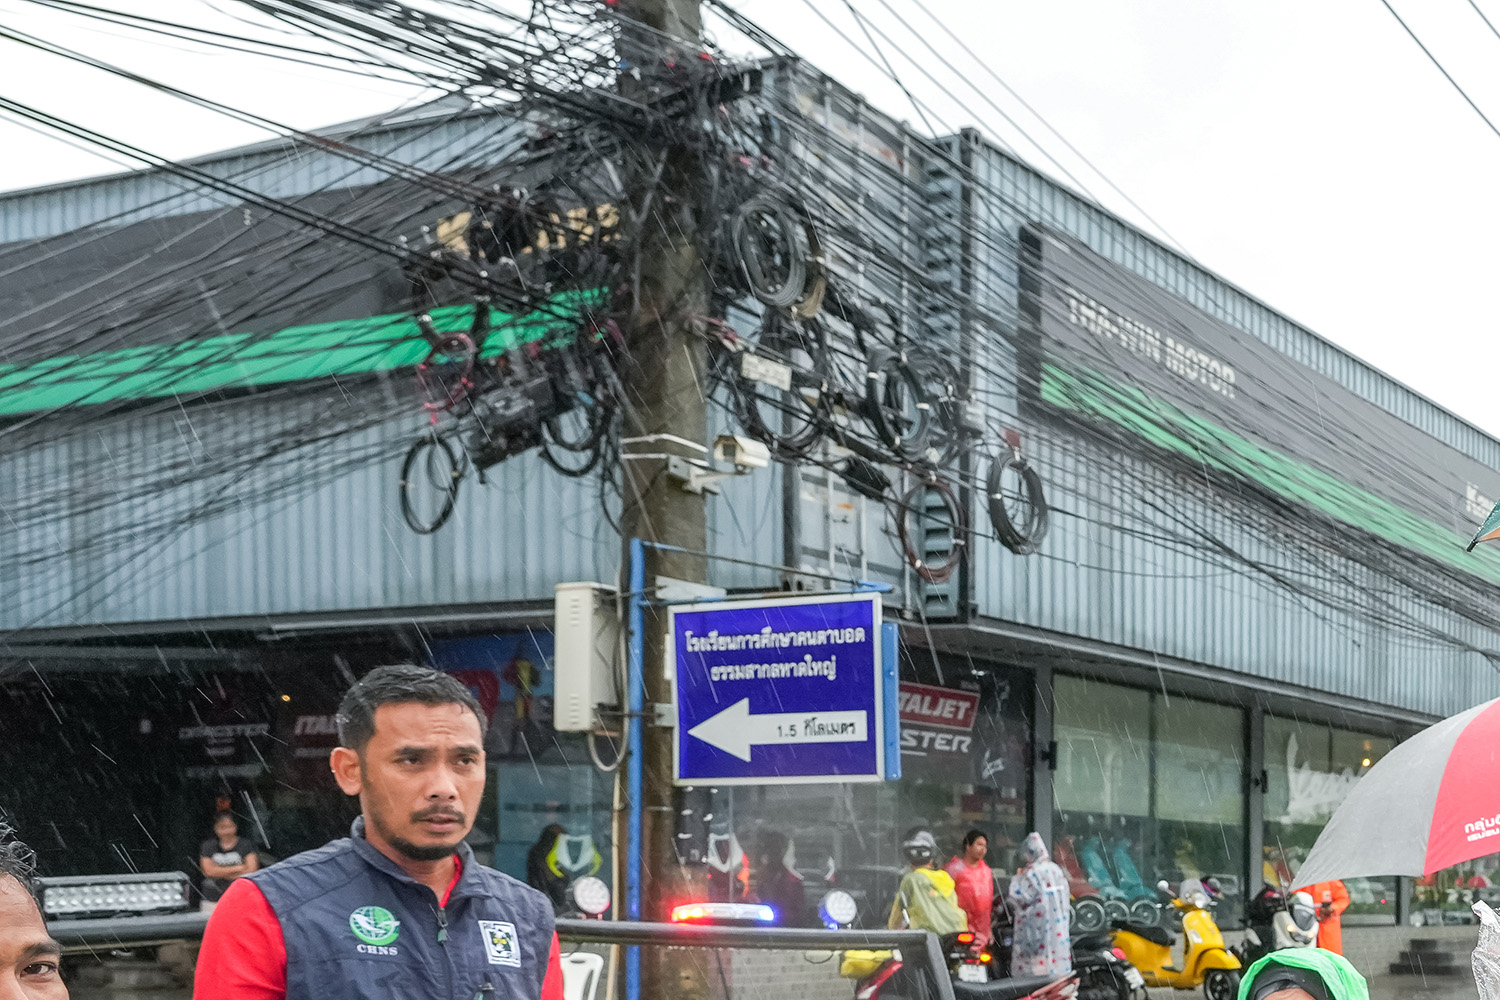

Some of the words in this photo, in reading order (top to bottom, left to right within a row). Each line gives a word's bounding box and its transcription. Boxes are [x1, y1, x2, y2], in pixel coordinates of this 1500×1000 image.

[684, 626, 866, 653] โรงเรียนการศึกษาคนตาบอด
[777, 725, 797, 738] 1.5
[356, 944, 399, 956] CHNS
